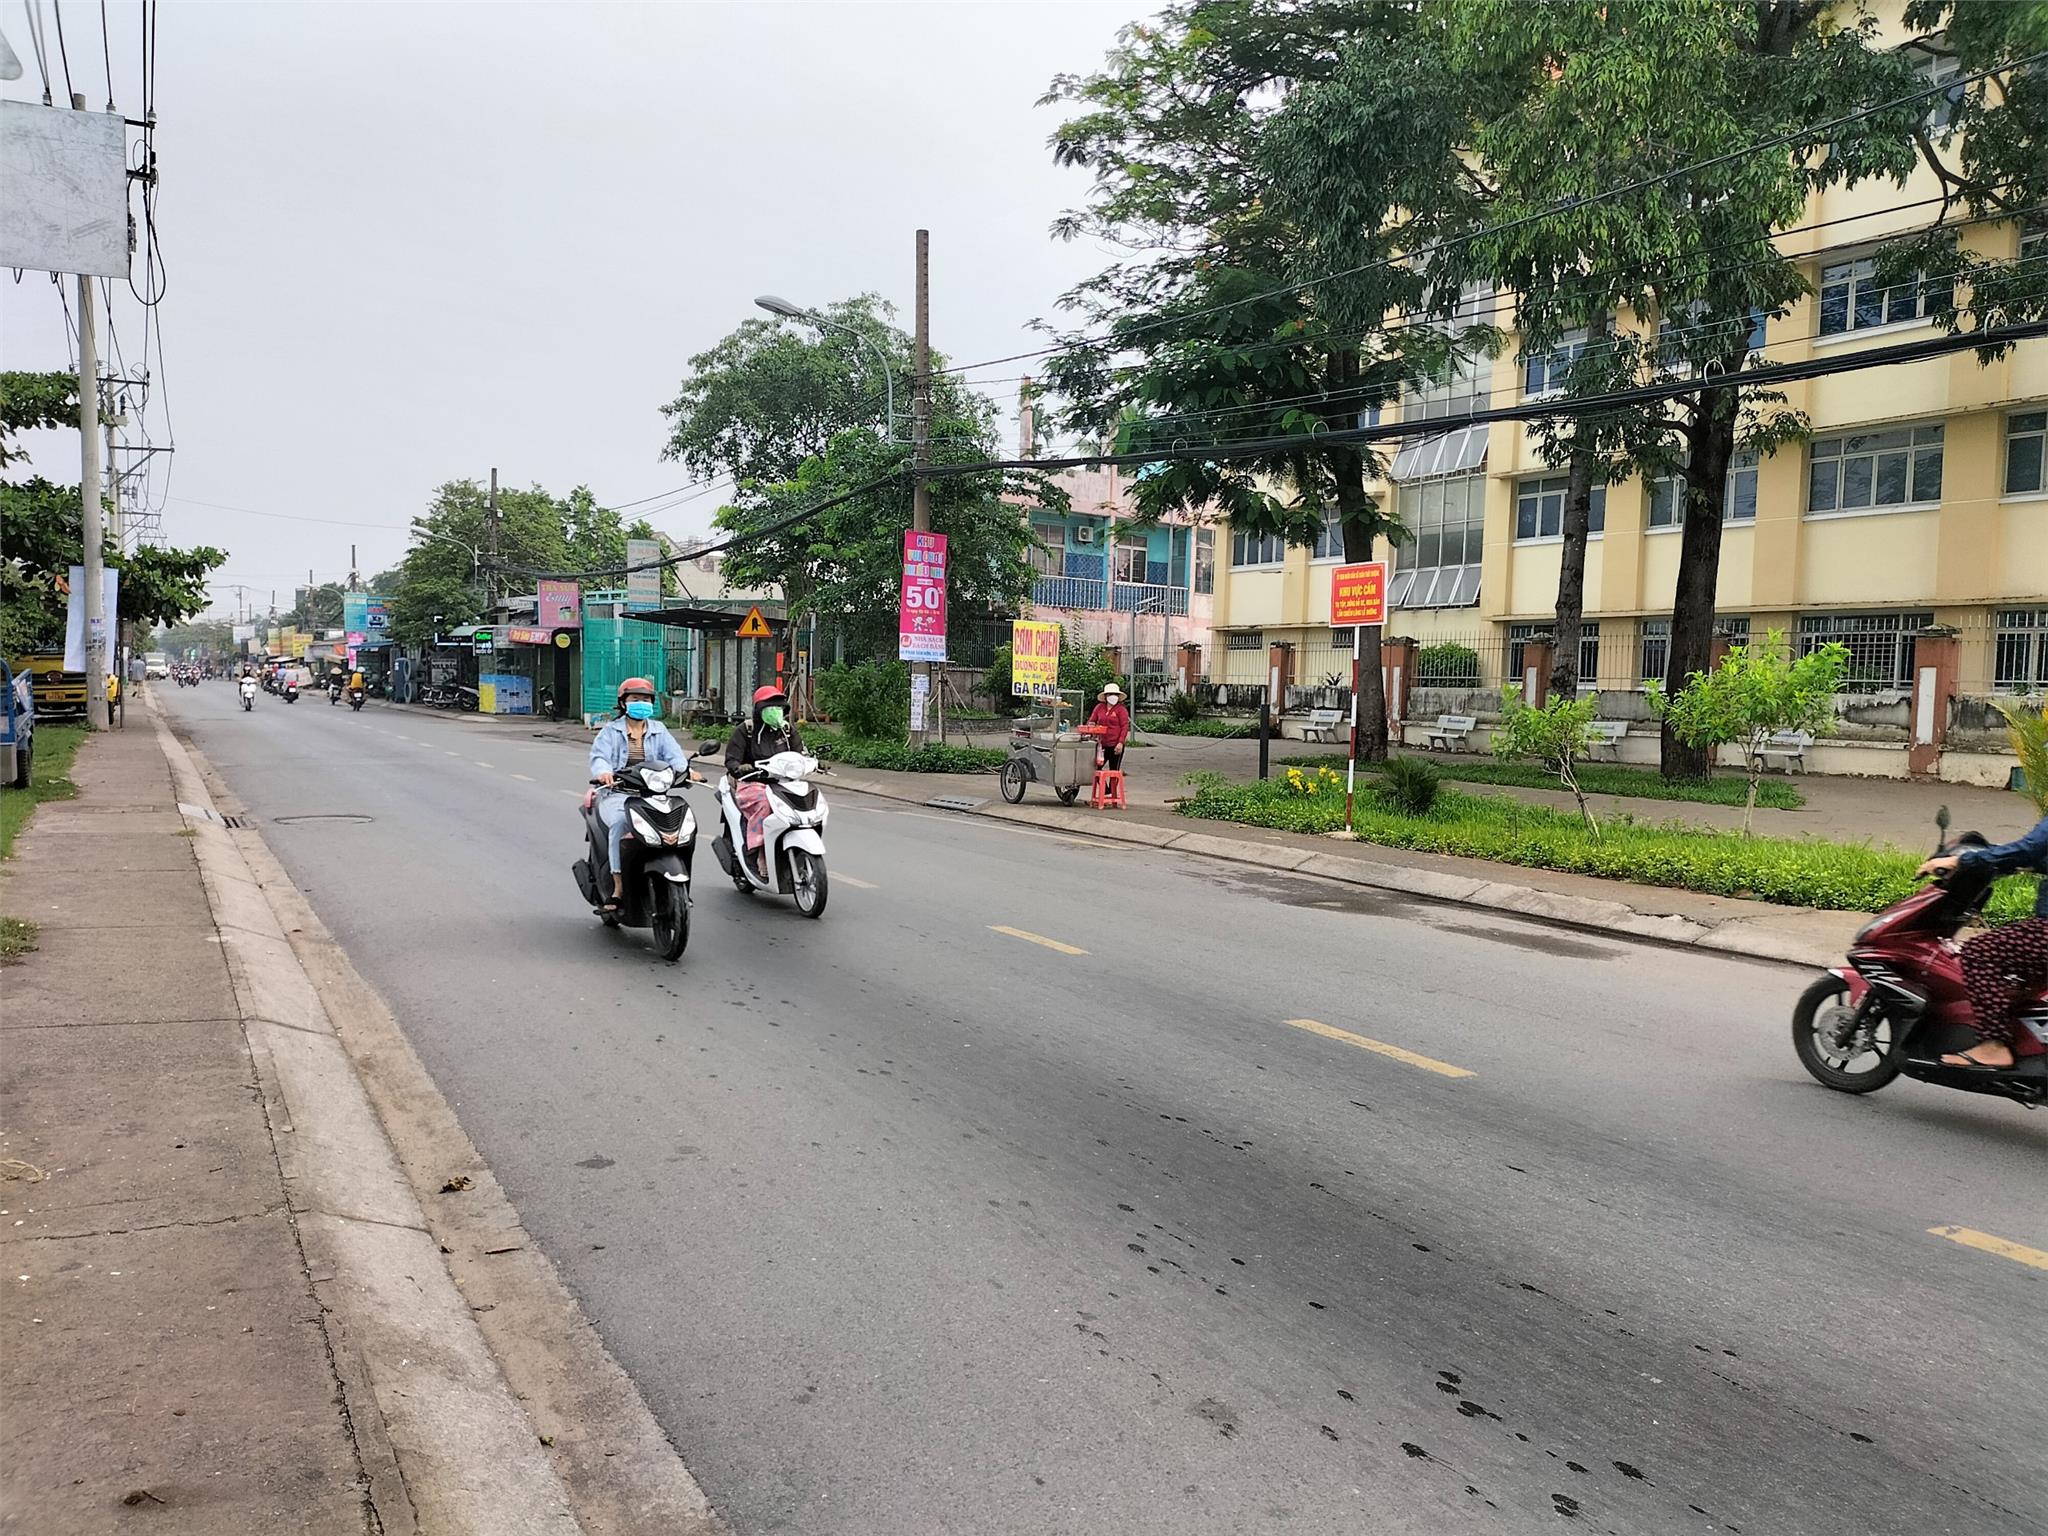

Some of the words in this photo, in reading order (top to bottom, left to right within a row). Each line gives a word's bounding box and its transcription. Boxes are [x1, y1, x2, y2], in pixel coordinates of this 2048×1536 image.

[1339, 586, 1350, 597] KHU
[1351, 584, 1362, 598] VỰC
[1363, 580, 1376, 595] CẤM
[1015, 626, 1032, 655] CƠM
[1014, 680, 1029, 694] GÀ
[1033, 681, 1055, 696] RÁN
